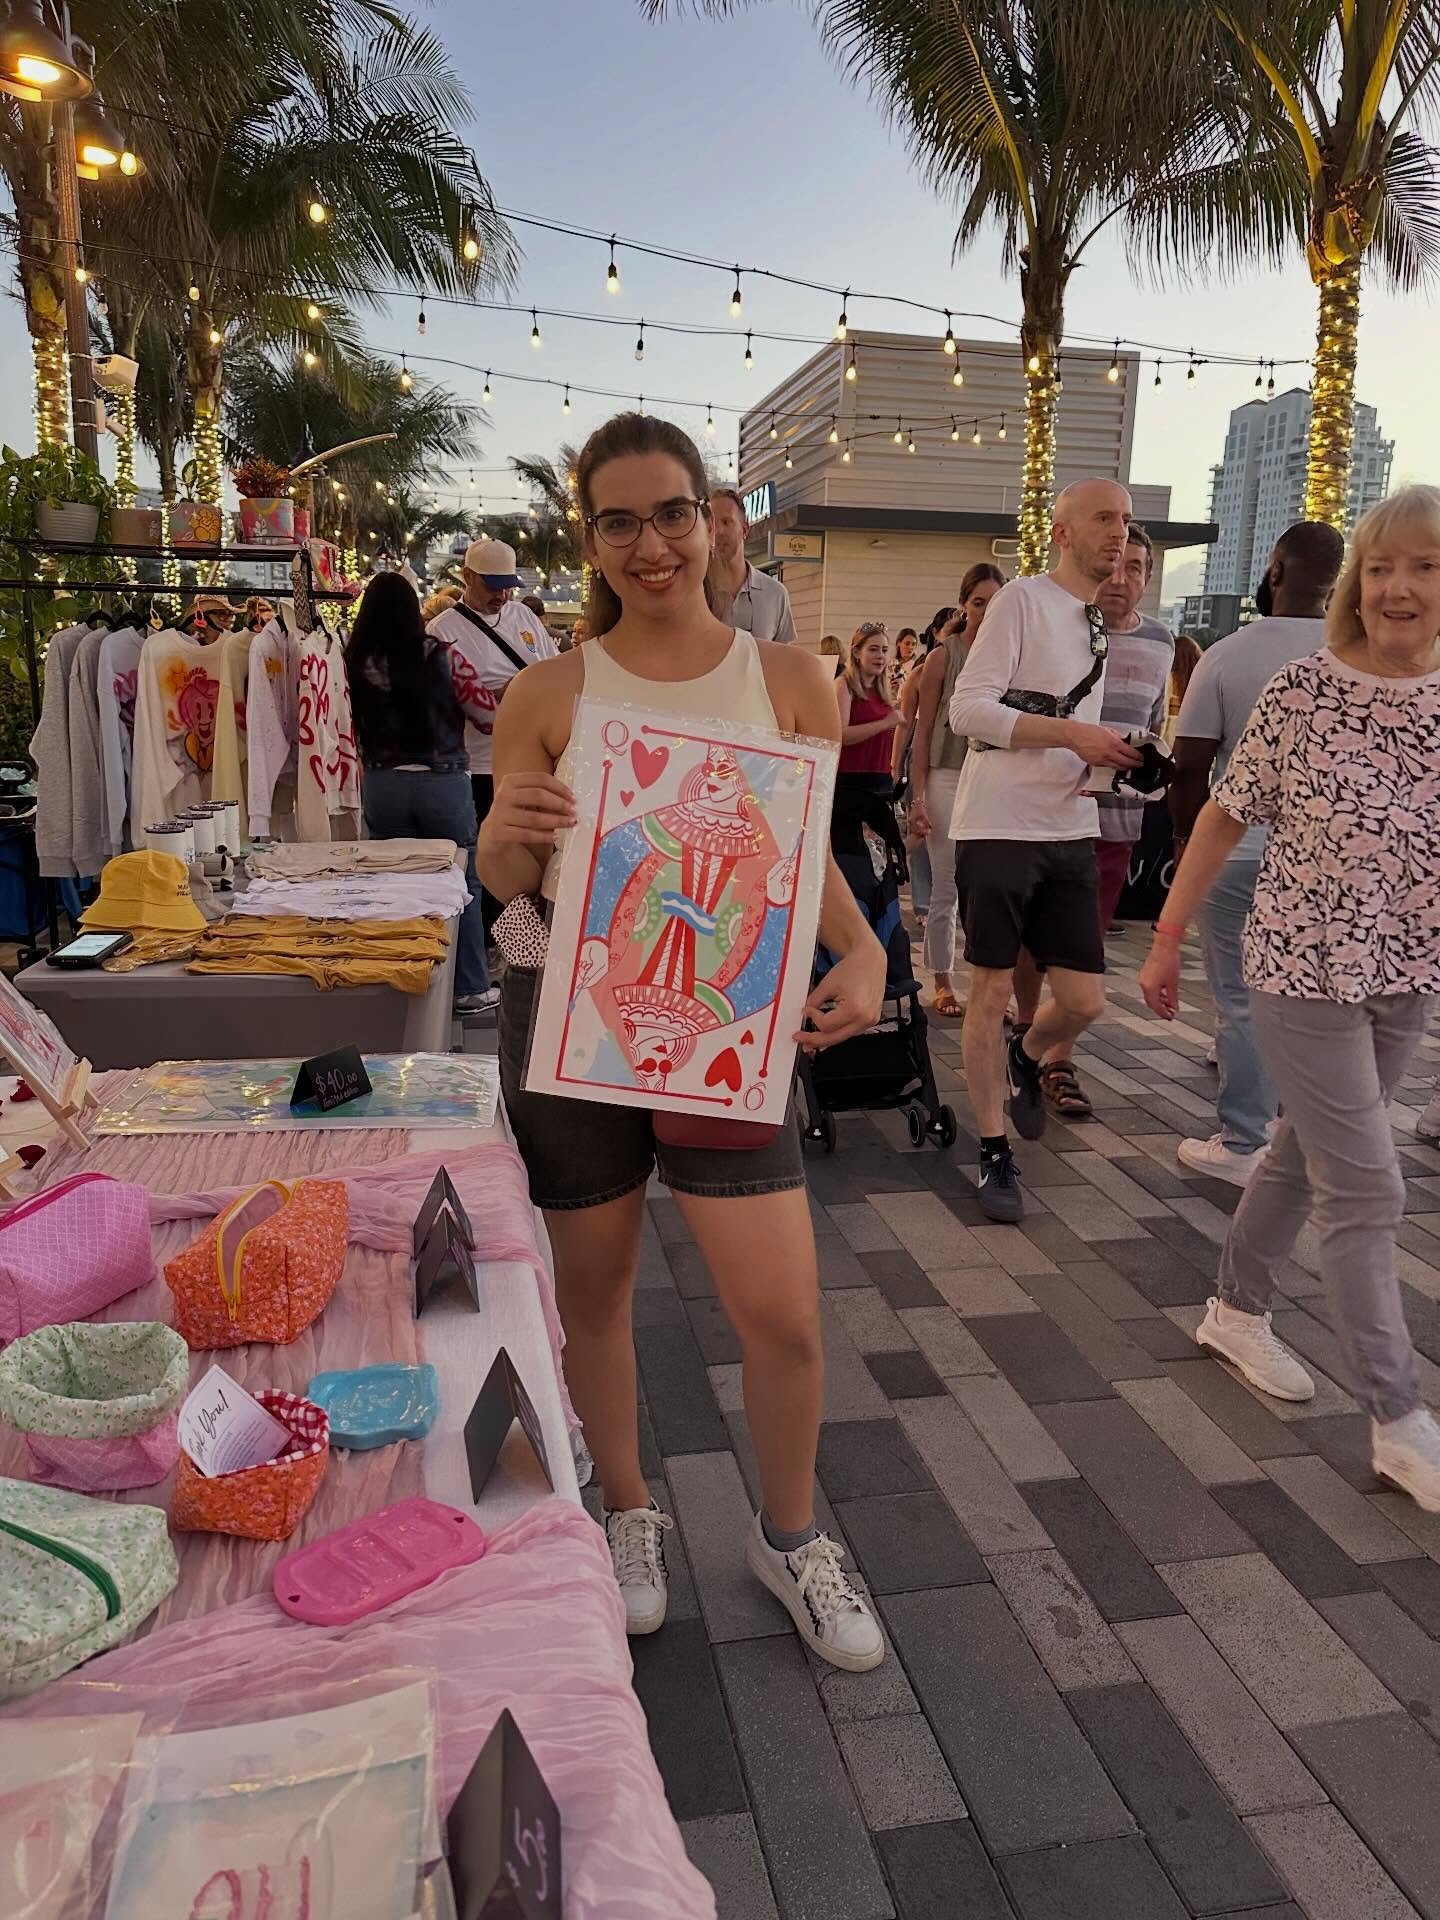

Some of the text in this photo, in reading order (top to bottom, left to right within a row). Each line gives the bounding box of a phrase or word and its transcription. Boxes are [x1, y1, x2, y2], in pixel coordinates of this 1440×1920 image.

[601, 720, 629, 757] Q
[315, 1068, 358, 1095] $40.00
[743, 1081, 767, 1112] Q
[198, 1388, 230, 1440] You!
